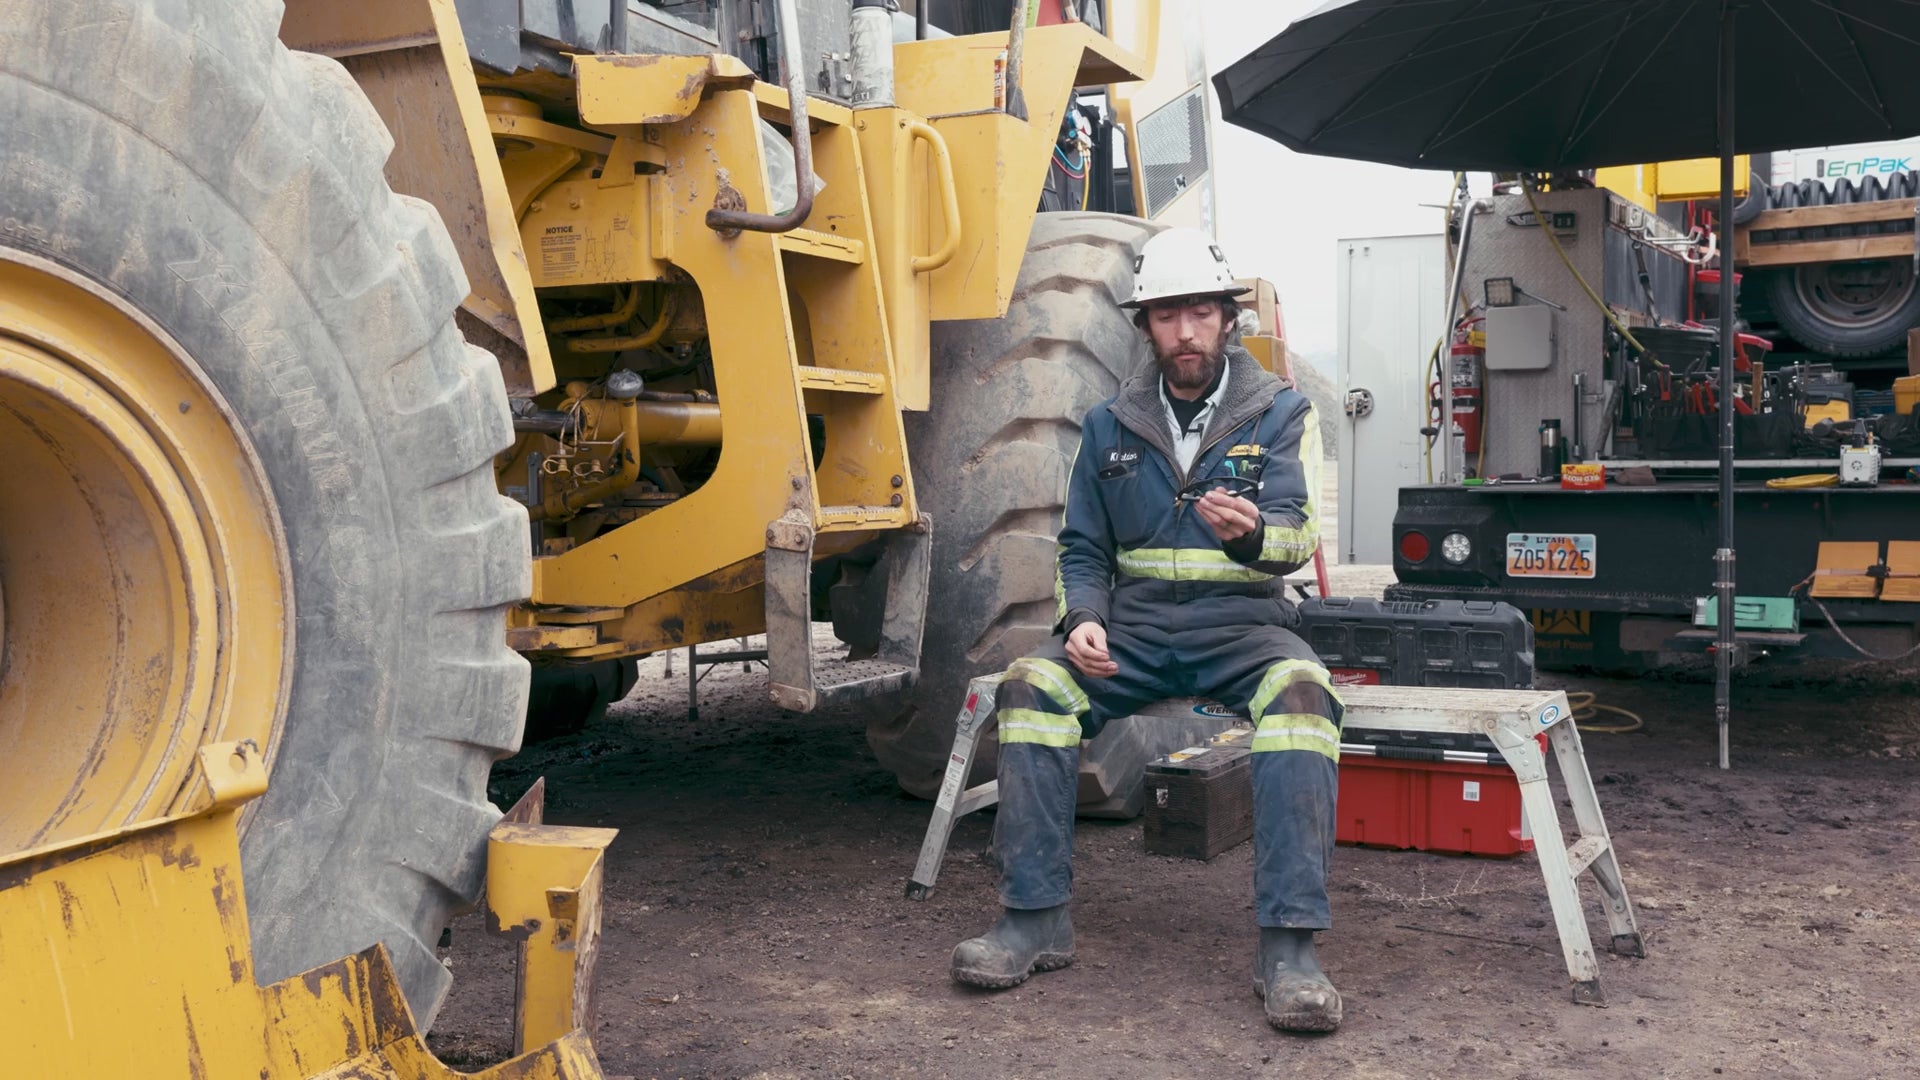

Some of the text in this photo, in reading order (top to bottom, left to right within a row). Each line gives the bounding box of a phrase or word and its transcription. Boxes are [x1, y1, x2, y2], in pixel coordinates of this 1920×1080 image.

[1827, 157, 1911, 177] EnPak
[545, 226, 573, 234] NOTICE
[1536, 536, 1566, 544] UTAH
[1514, 549, 1590, 571] Z051225
